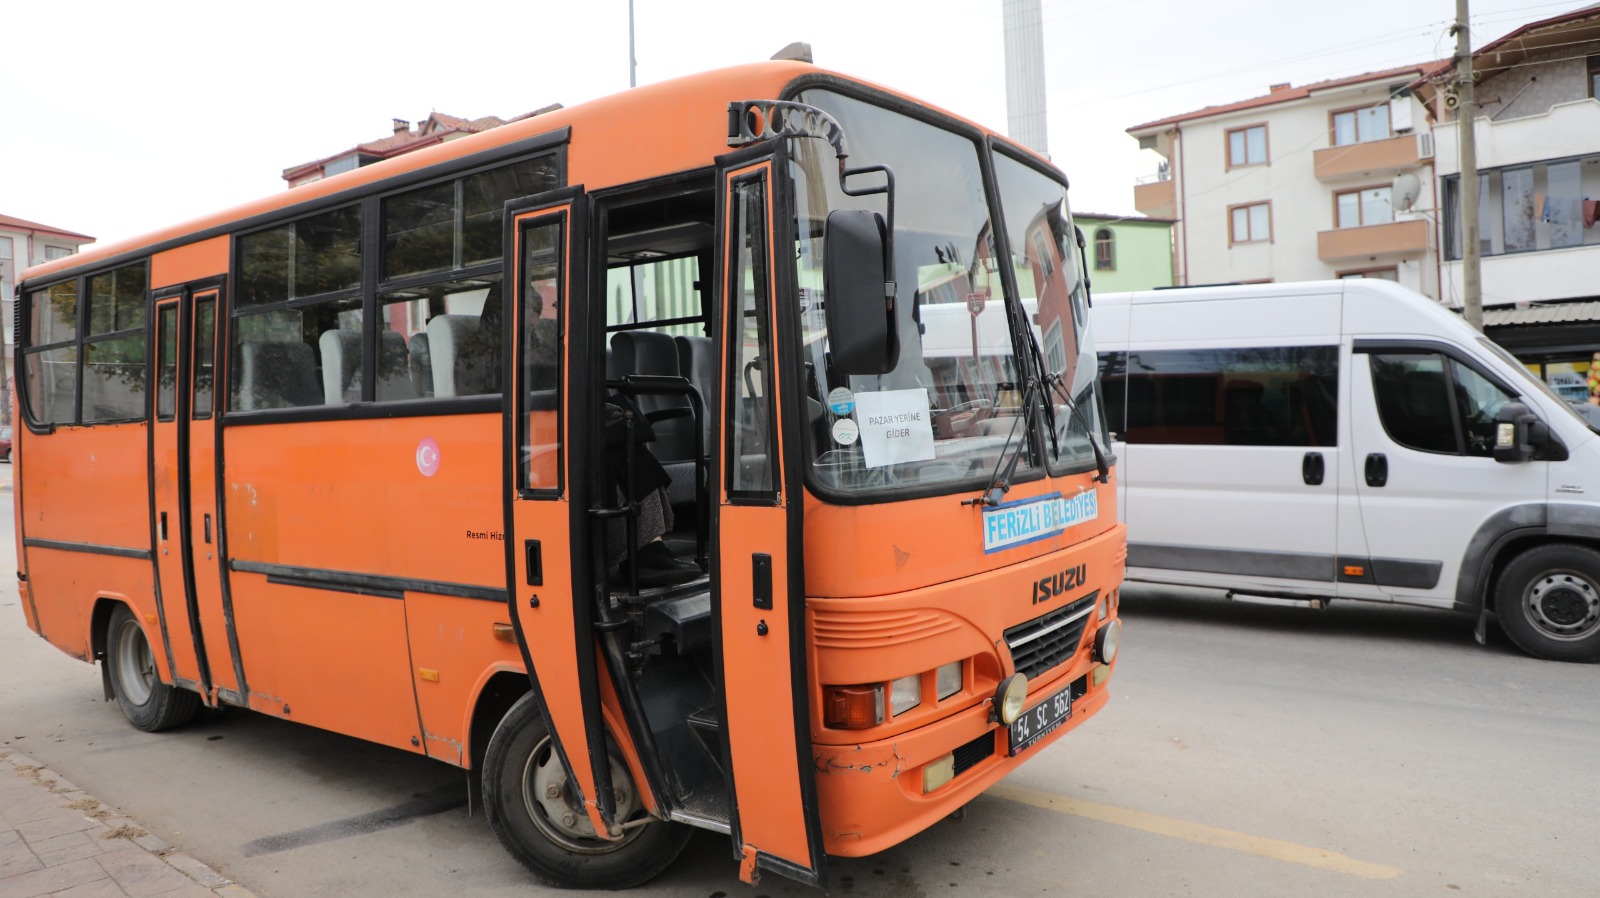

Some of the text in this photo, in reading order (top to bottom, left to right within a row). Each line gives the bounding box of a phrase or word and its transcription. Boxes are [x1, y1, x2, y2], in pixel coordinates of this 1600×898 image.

[869, 411, 920, 426] PAZAR YERİNE
[886, 428, 910, 439] GİDER
[466, 530, 489, 540] Resmi
[1032, 563, 1086, 606] ISUZU
[1017, 689, 1069, 743] 54 SC 562
